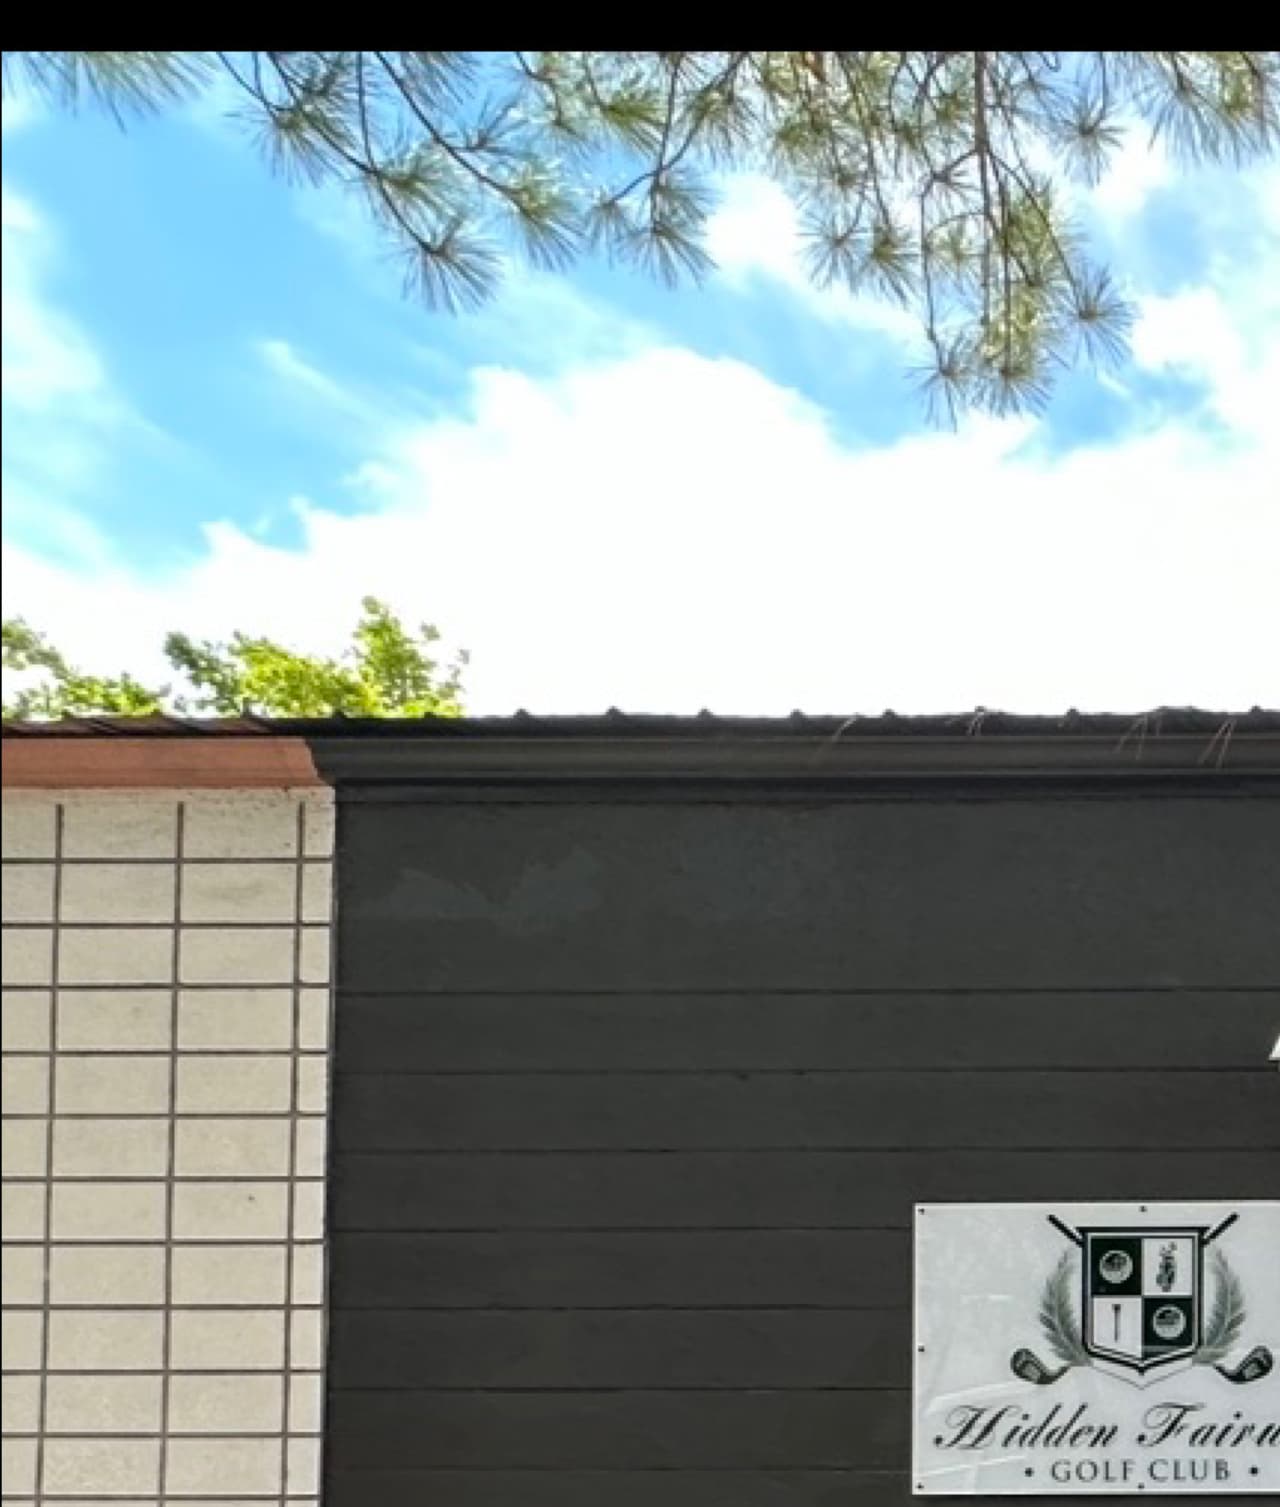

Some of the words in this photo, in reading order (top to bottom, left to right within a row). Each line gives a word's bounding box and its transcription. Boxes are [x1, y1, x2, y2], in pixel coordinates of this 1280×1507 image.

[933, 1401, 1119, 1450] Hidden
[1050, 1458, 1136, 1483] GOLF
[1148, 1458, 1231, 1483] CLUB
